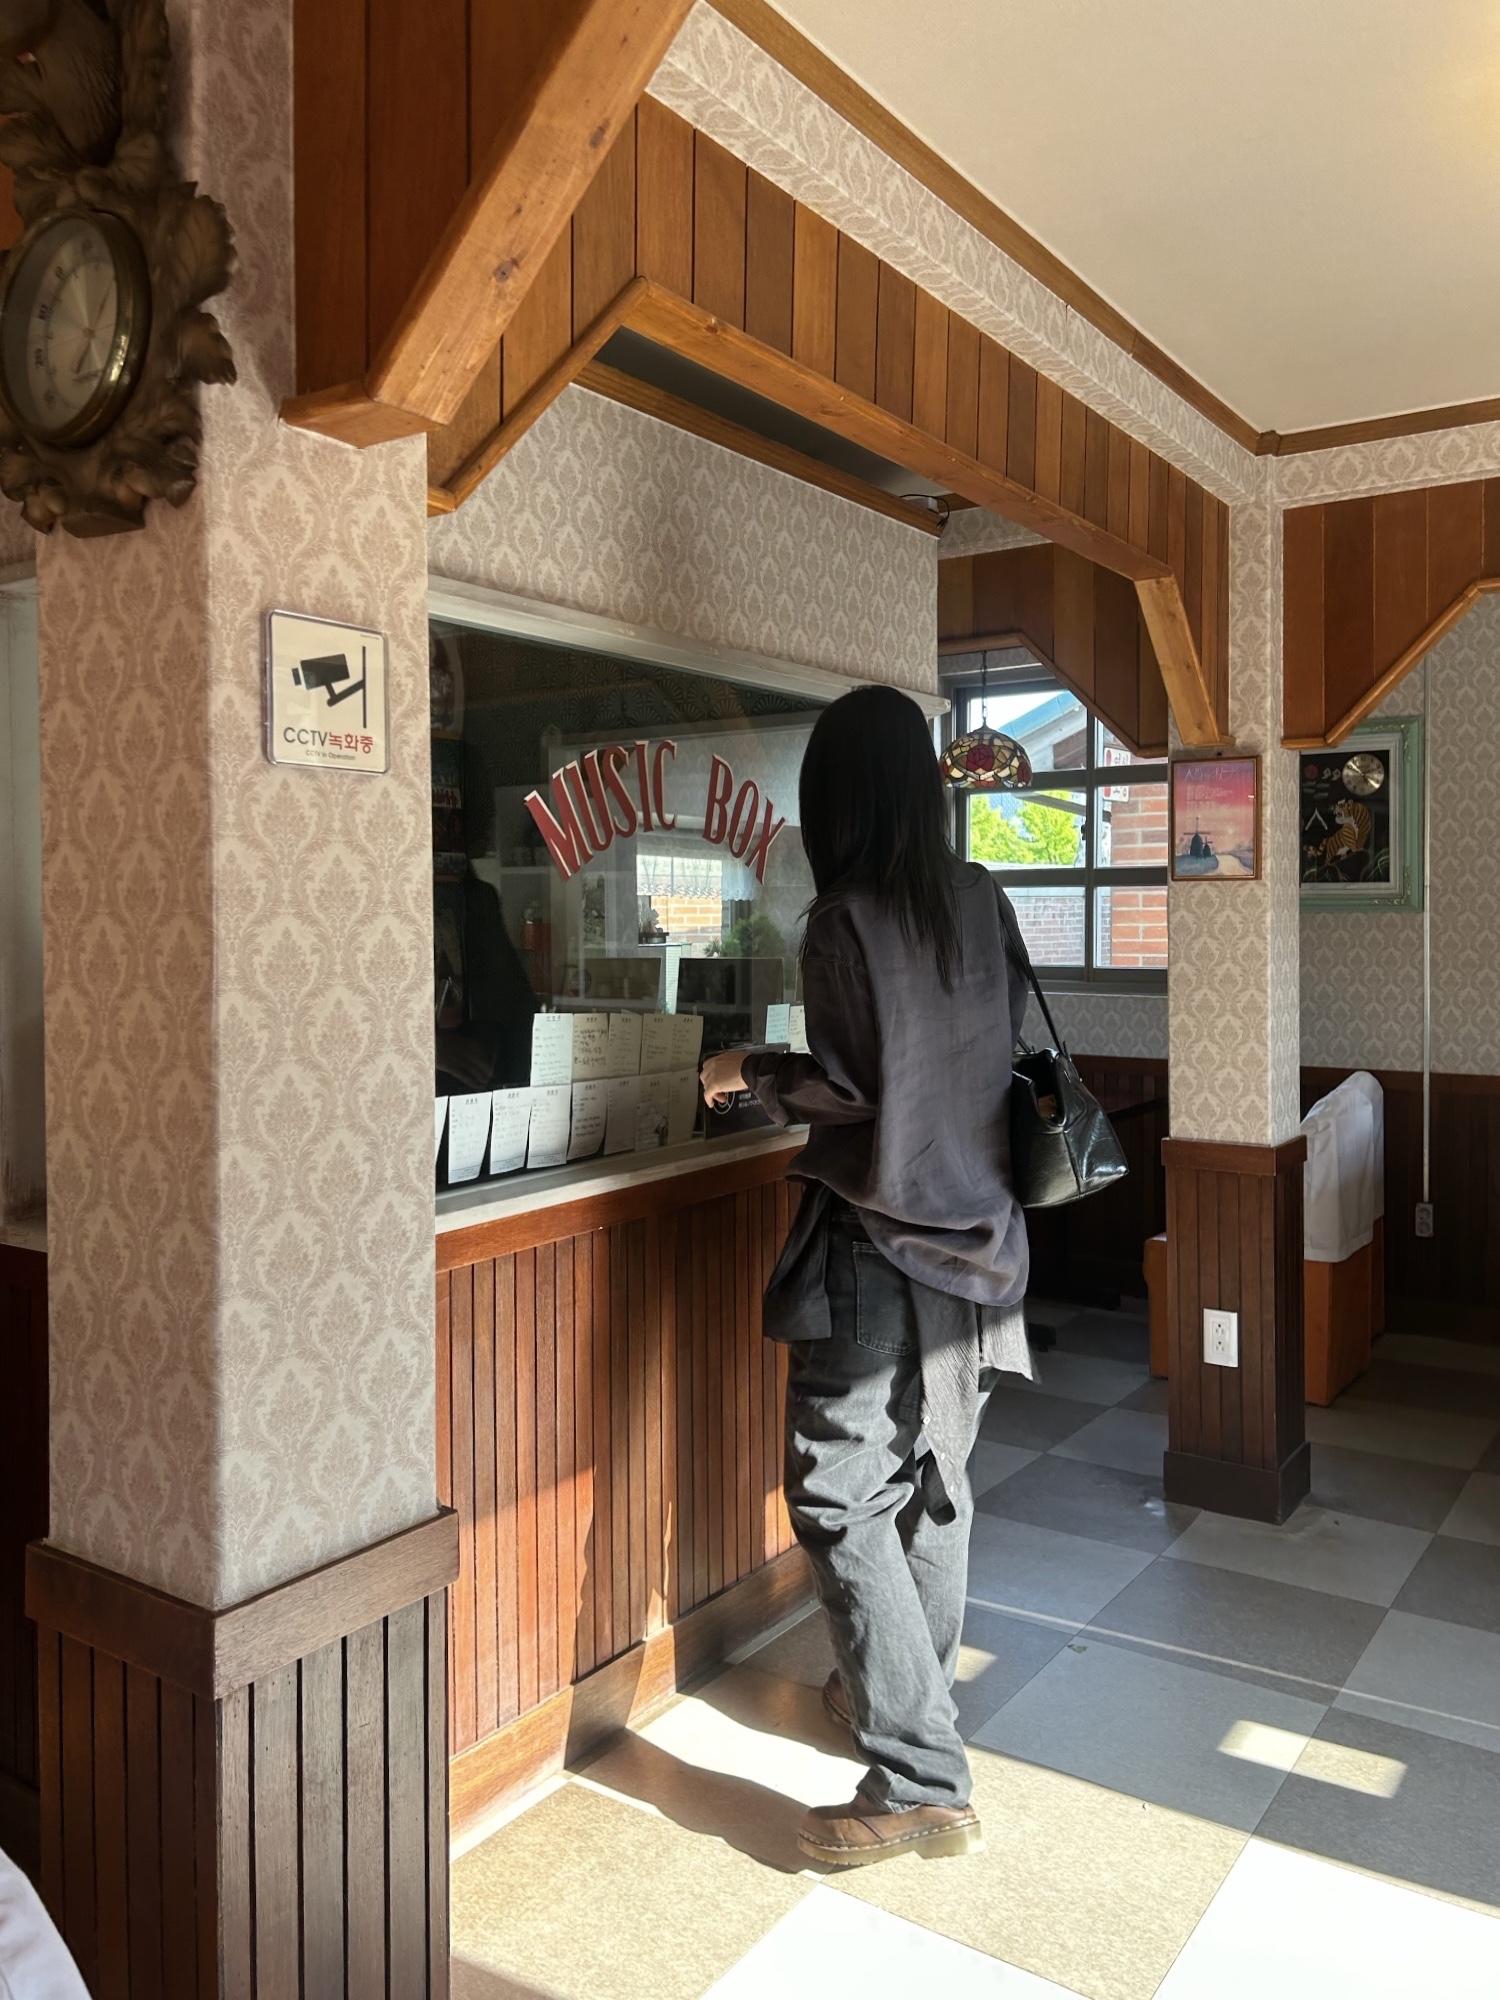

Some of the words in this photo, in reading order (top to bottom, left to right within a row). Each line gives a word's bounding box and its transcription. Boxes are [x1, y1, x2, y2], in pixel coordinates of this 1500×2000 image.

[284, 727, 373, 754] CCTV녹화중
[524, 740, 678, 883] MUSIC
[703, 753, 786, 885] BOX
